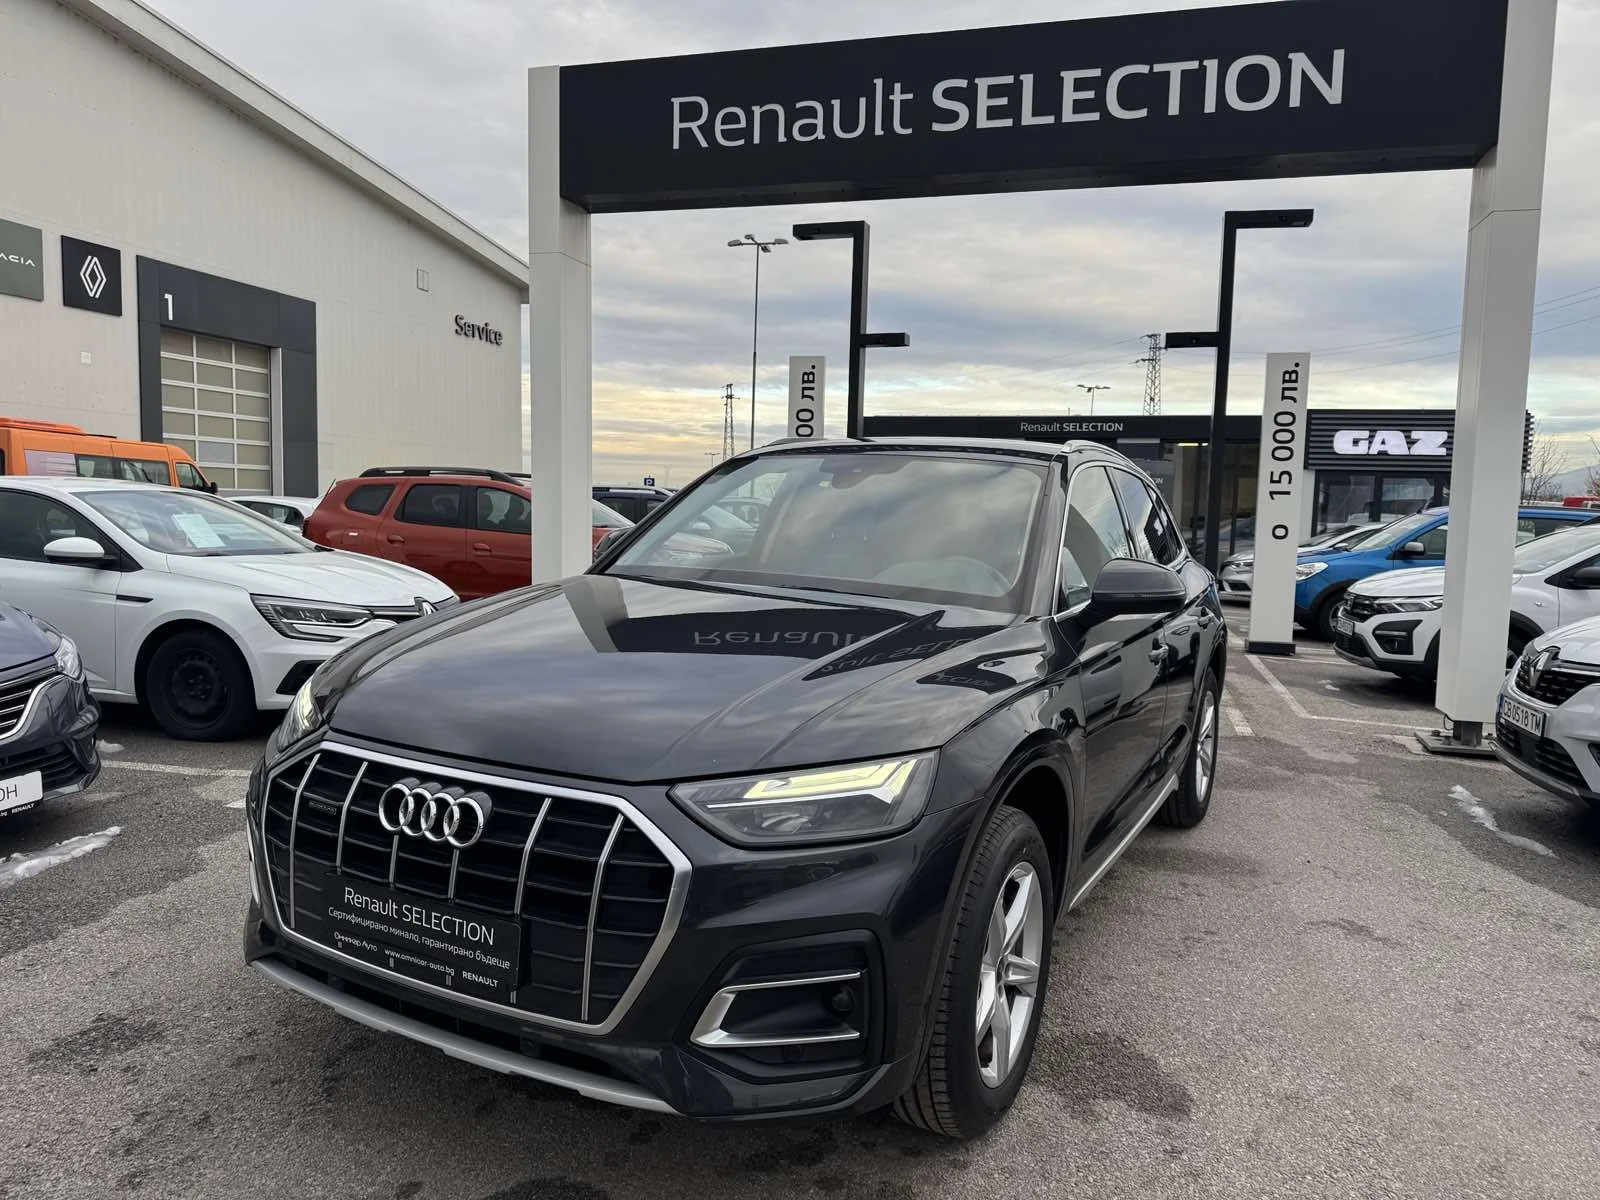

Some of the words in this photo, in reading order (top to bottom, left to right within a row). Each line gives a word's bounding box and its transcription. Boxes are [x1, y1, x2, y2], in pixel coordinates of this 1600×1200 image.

[670, 78, 913, 150] Renault
[930, 48, 1346, 134] SELECTION
[164, 293, 173, 321] 1
[454, 314, 503, 346] Service
[801, 364, 816, 402] лв.
[1280, 361, 1301, 404] лв.
[1020, 422, 1060, 432] Renault
[1062, 422, 1124, 432] SELECTION
[1271, 410, 1297, 462] 000
[1333, 429, 1449, 456] GAZ
[1268, 469, 1293, 501] 15
[344, 886, 398, 919] Renault
[402, 904, 494, 946] SELECTION
[328, 907, 389, 933] Сертифицирано
[389, 926, 420, 944] минало,
[421, 936, 474, 958] гарантирано
[475, 950, 511, 969] бъдеще
[462, 970, 499, 988] RENAULT
